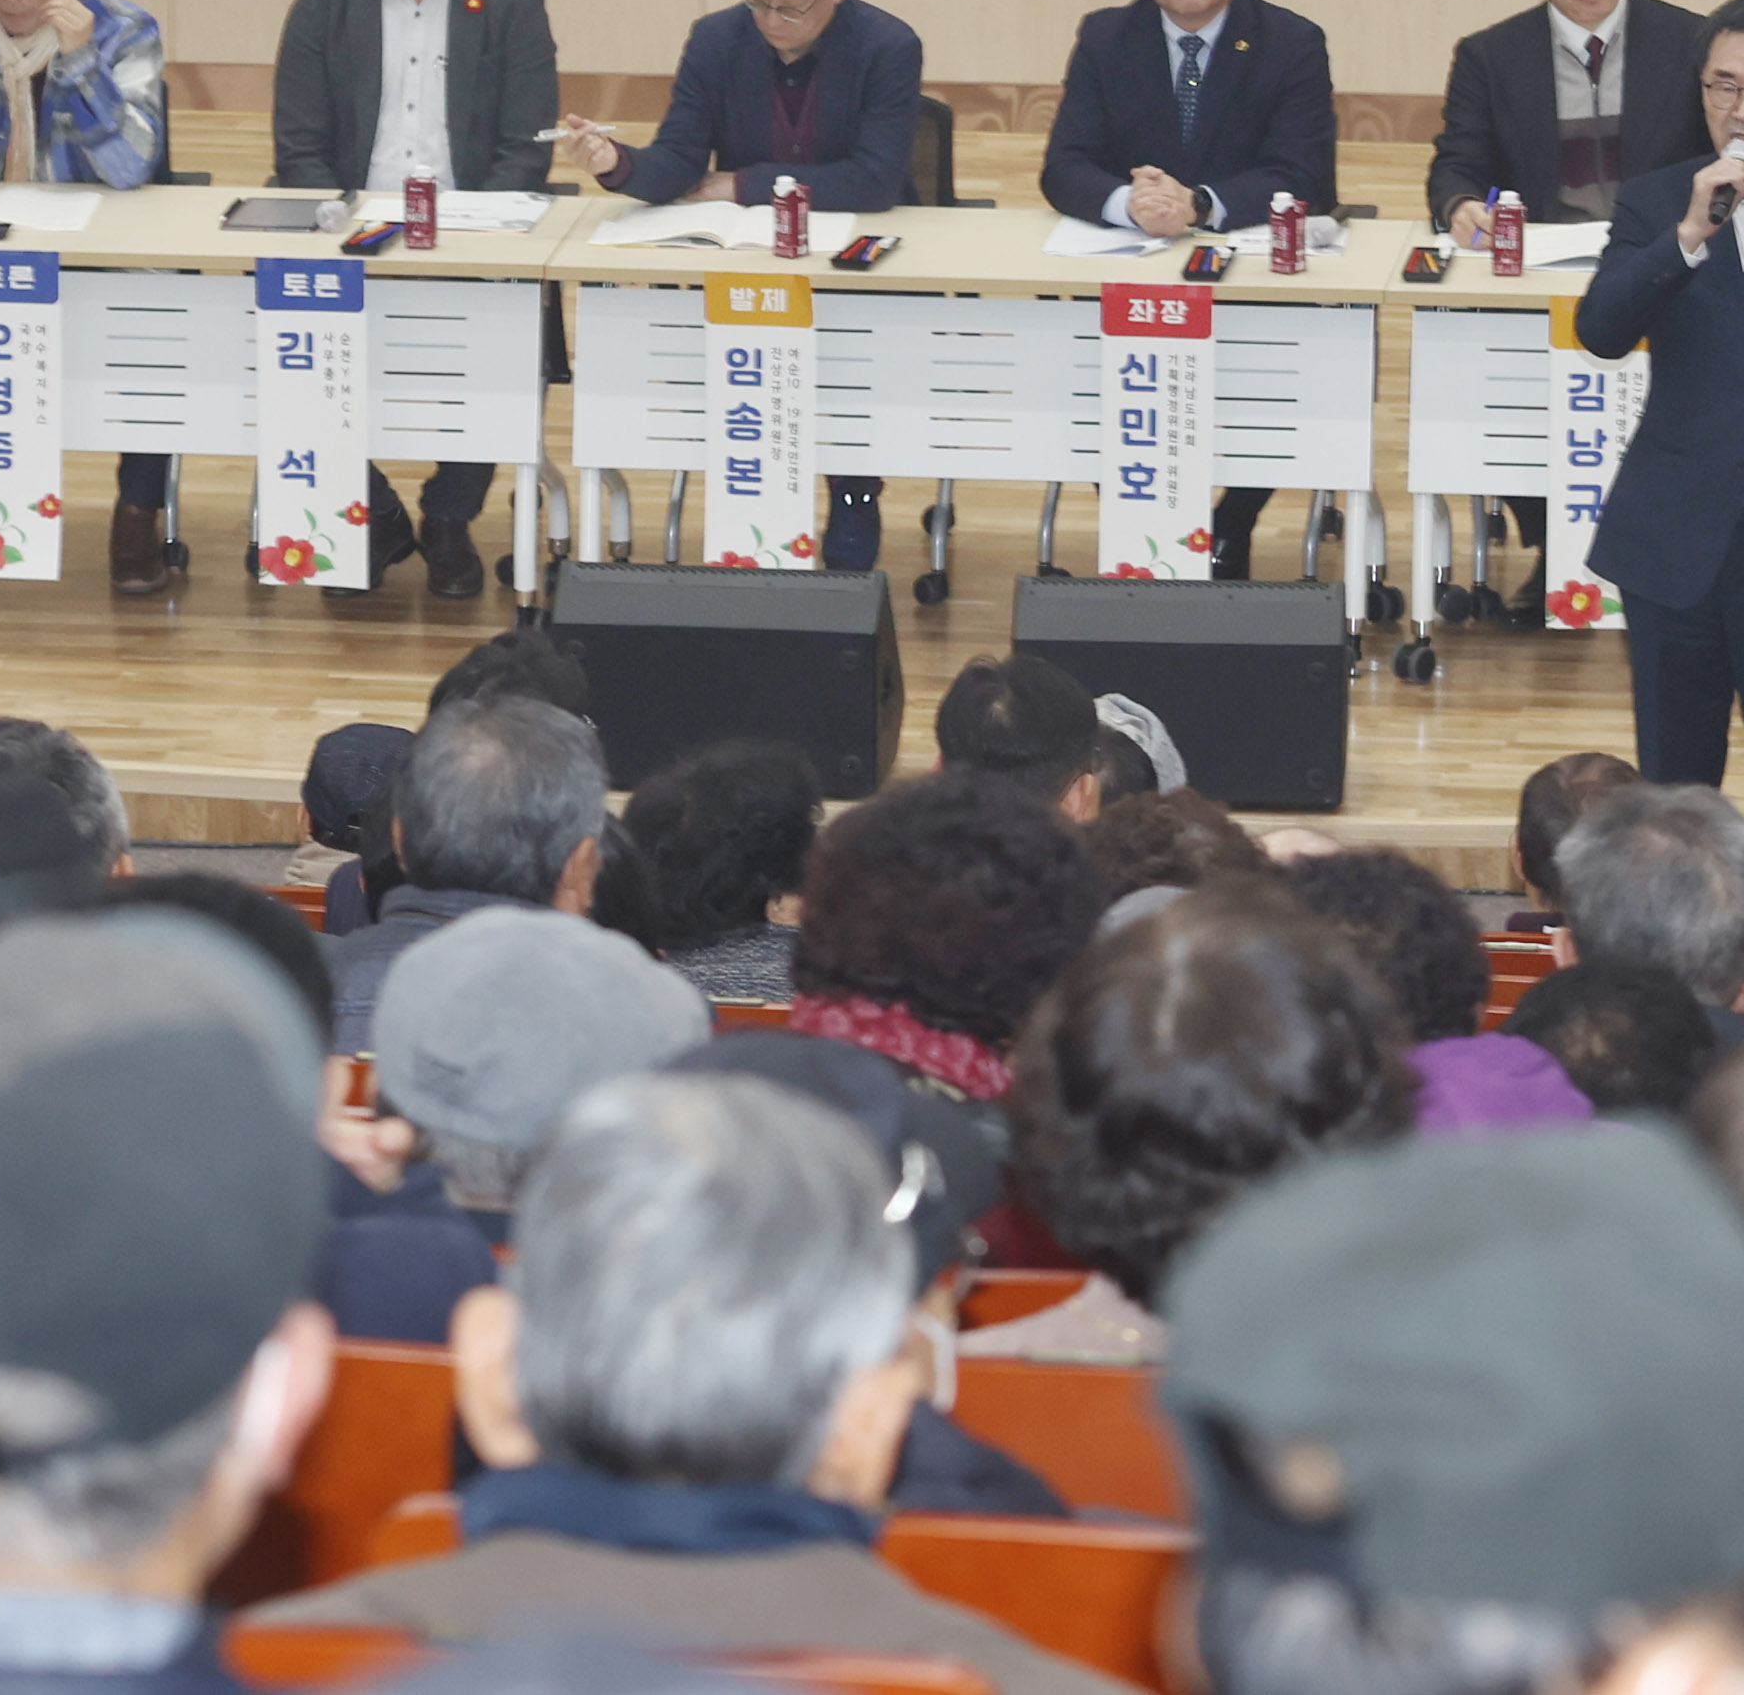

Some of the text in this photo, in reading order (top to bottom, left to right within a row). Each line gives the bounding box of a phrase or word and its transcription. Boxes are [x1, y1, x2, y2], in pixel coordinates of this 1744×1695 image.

[282, 272, 342, 299] 토론
[729, 287, 790, 314] 발제
[1127, 298, 1190, 325] 좌장
[724, 347, 764, 497] 임송본
[1118, 353, 1159, 502] 신민호
[1565, 372, 1608, 524] 김낭규
